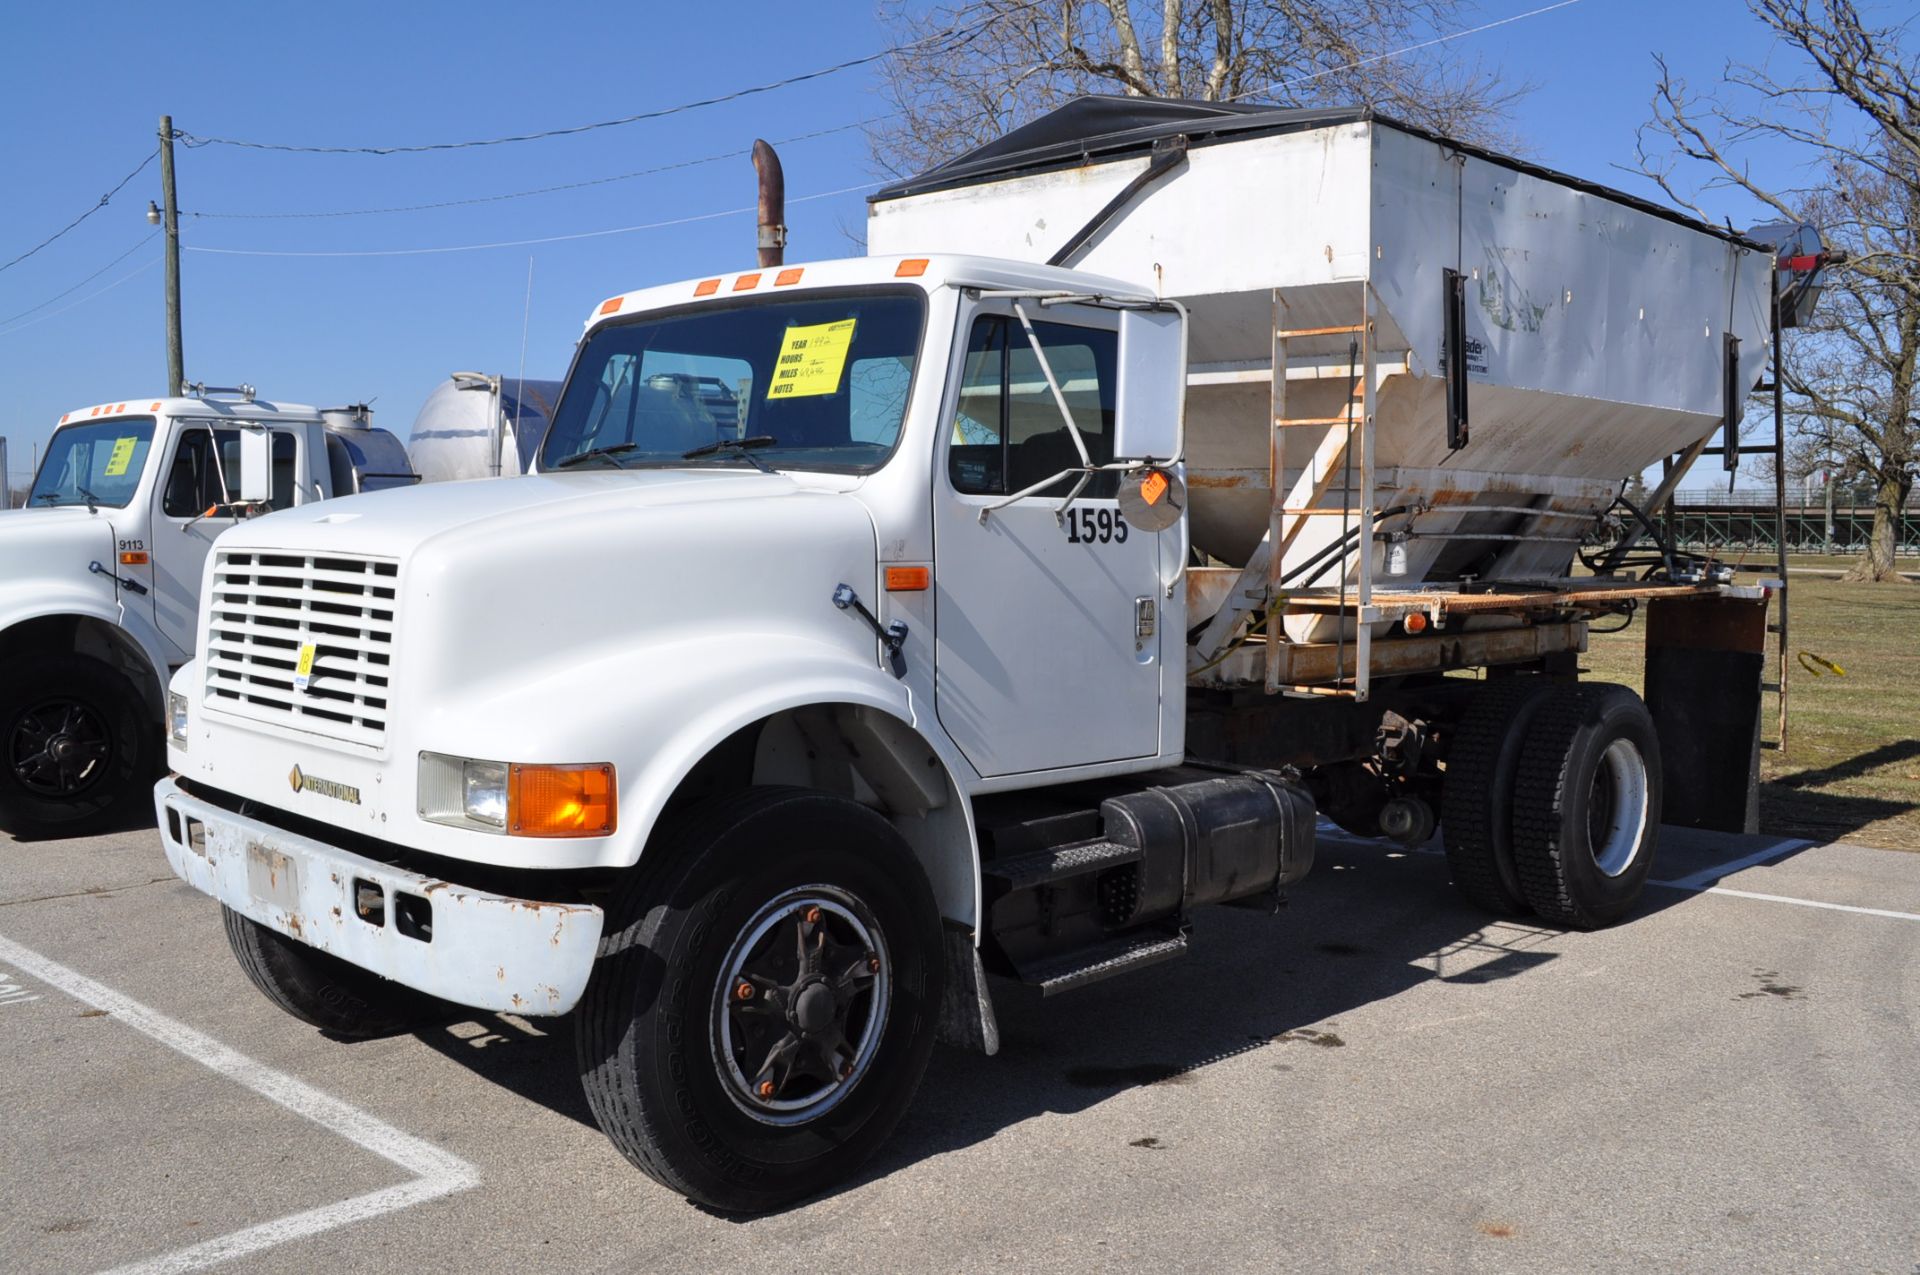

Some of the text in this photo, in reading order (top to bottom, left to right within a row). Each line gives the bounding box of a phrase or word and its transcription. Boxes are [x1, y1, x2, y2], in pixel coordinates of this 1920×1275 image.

[791, 339, 808, 350] YEAR
[780, 353, 803, 364] HOURS
[779, 368, 799, 379] MILES
[773, 383, 793, 394] NOTES
[1067, 508, 1128, 543] 1595
[119, 539, 144, 550] 9113
[302, 774, 361, 805] INTERNATIONAL
